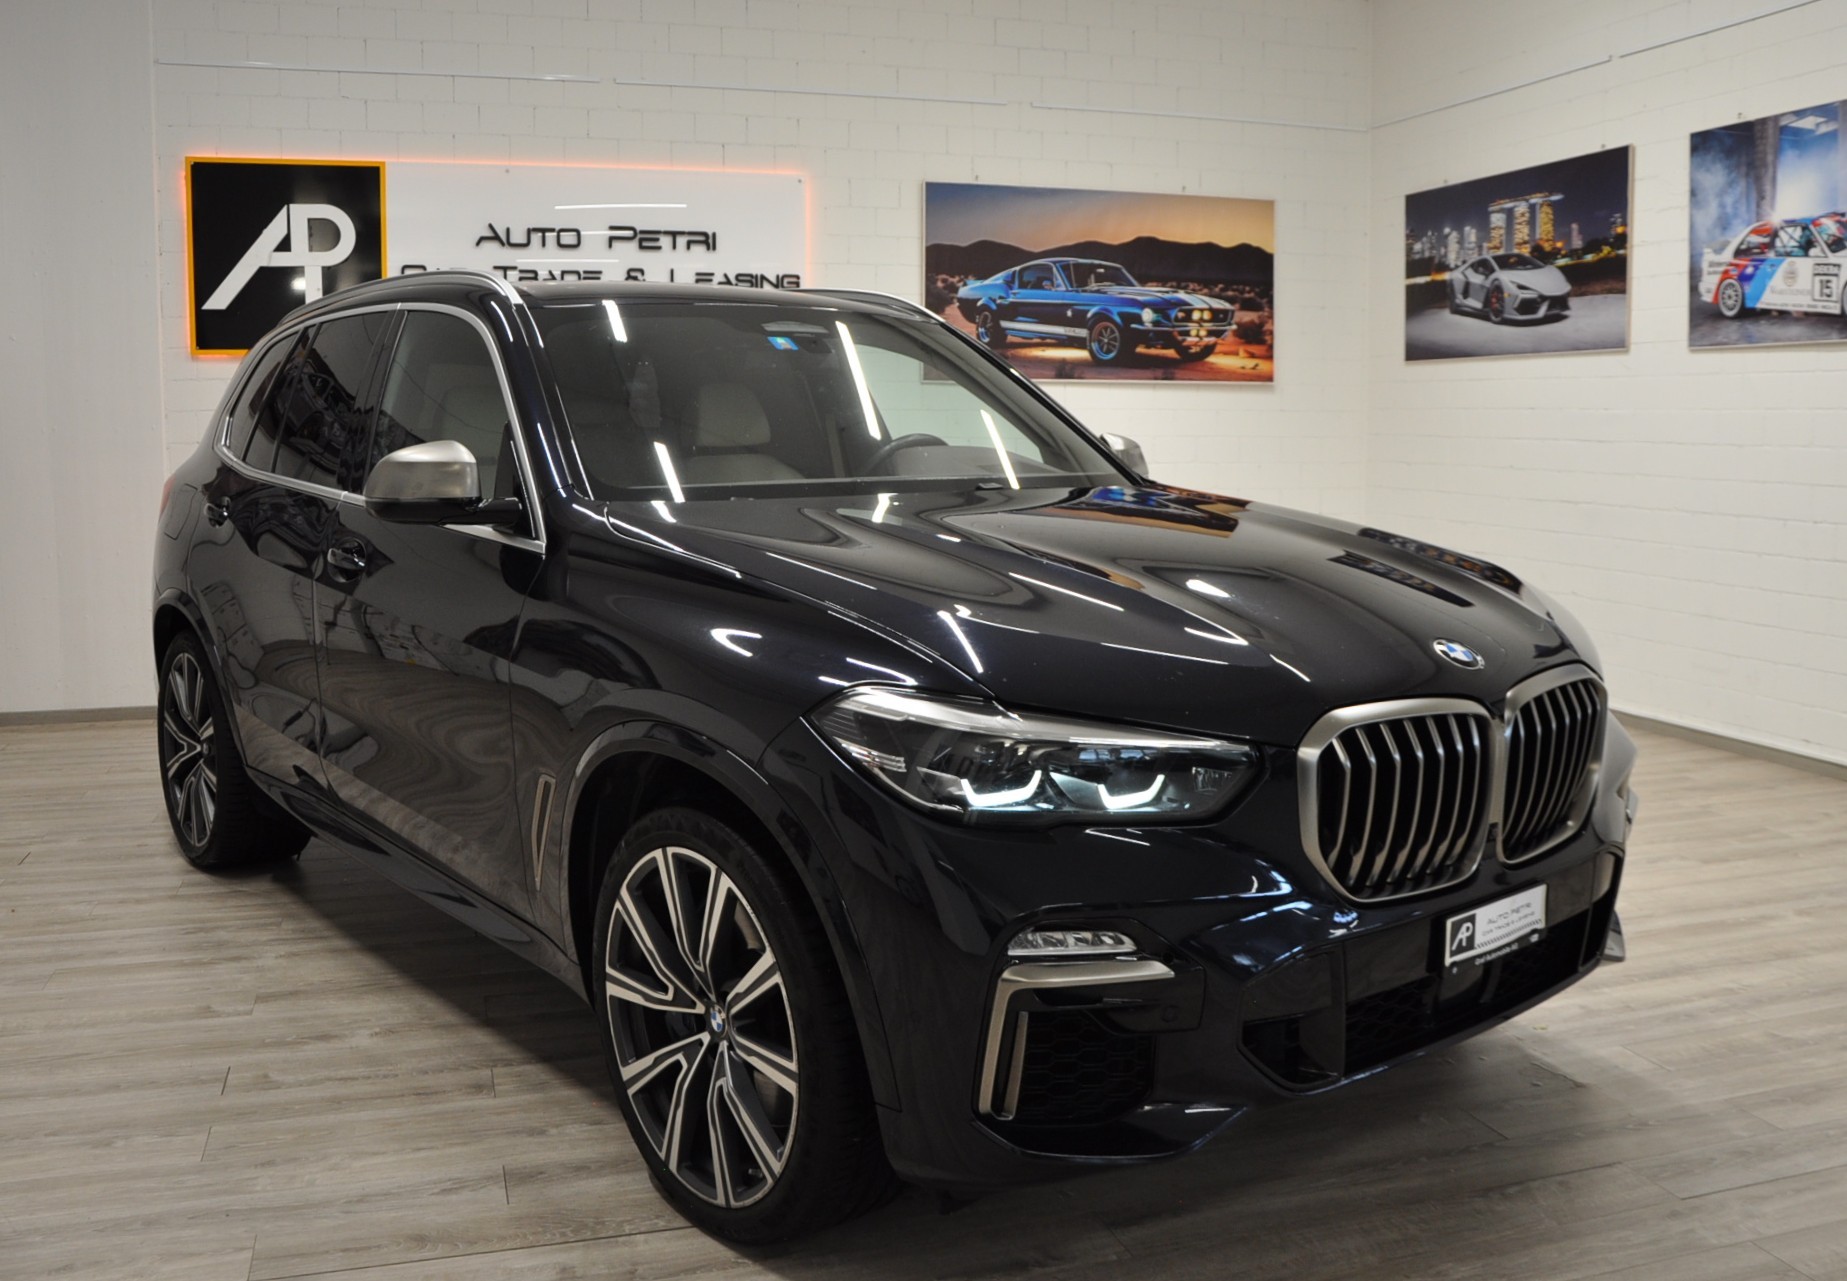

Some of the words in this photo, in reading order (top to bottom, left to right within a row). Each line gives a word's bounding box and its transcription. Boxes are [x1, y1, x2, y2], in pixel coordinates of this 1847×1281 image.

[475, 222, 582, 249] AUTO
[608, 225, 717, 251] PETRI
[201, 203, 356, 310] AP
[1819, 278, 1833, 298] 15
